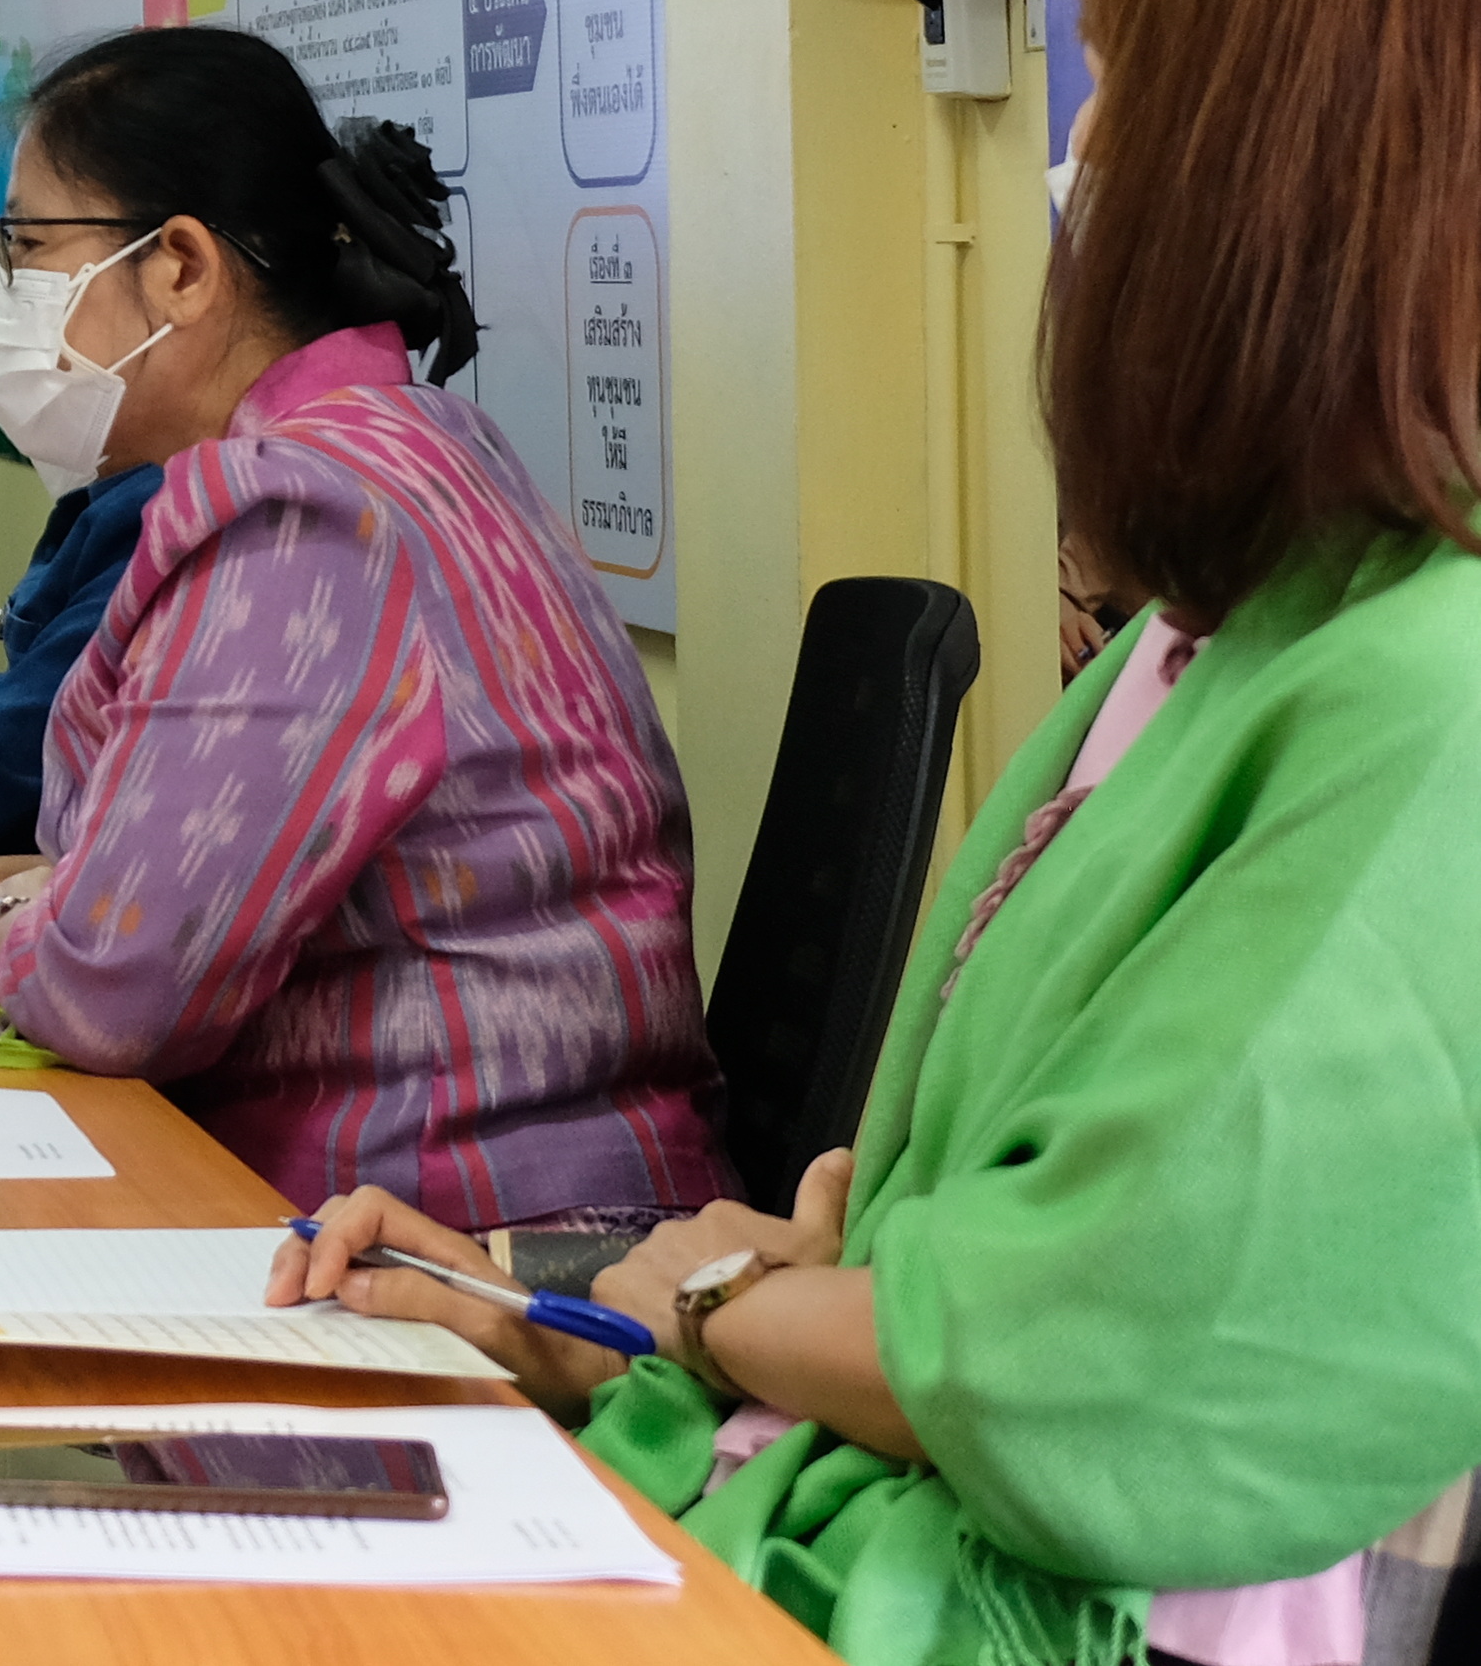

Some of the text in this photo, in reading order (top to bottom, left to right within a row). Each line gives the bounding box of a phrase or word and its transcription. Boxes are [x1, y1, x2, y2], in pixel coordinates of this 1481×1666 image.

[469, 23, 532, 73] การพัฒนา
[584, 9, 624, 60] ชุมชน
[569, 62, 644, 118] พึ่งตนเองได้
[588, 234, 621, 281] เรื่องที่
[583, 302, 643, 348] เสริมสร้าง
[586, 375, 642, 420] ทุนชุมชน
[602, 424, 628, 470] ให้มี
[581, 490, 654, 537] ธรรมาภิบาล
